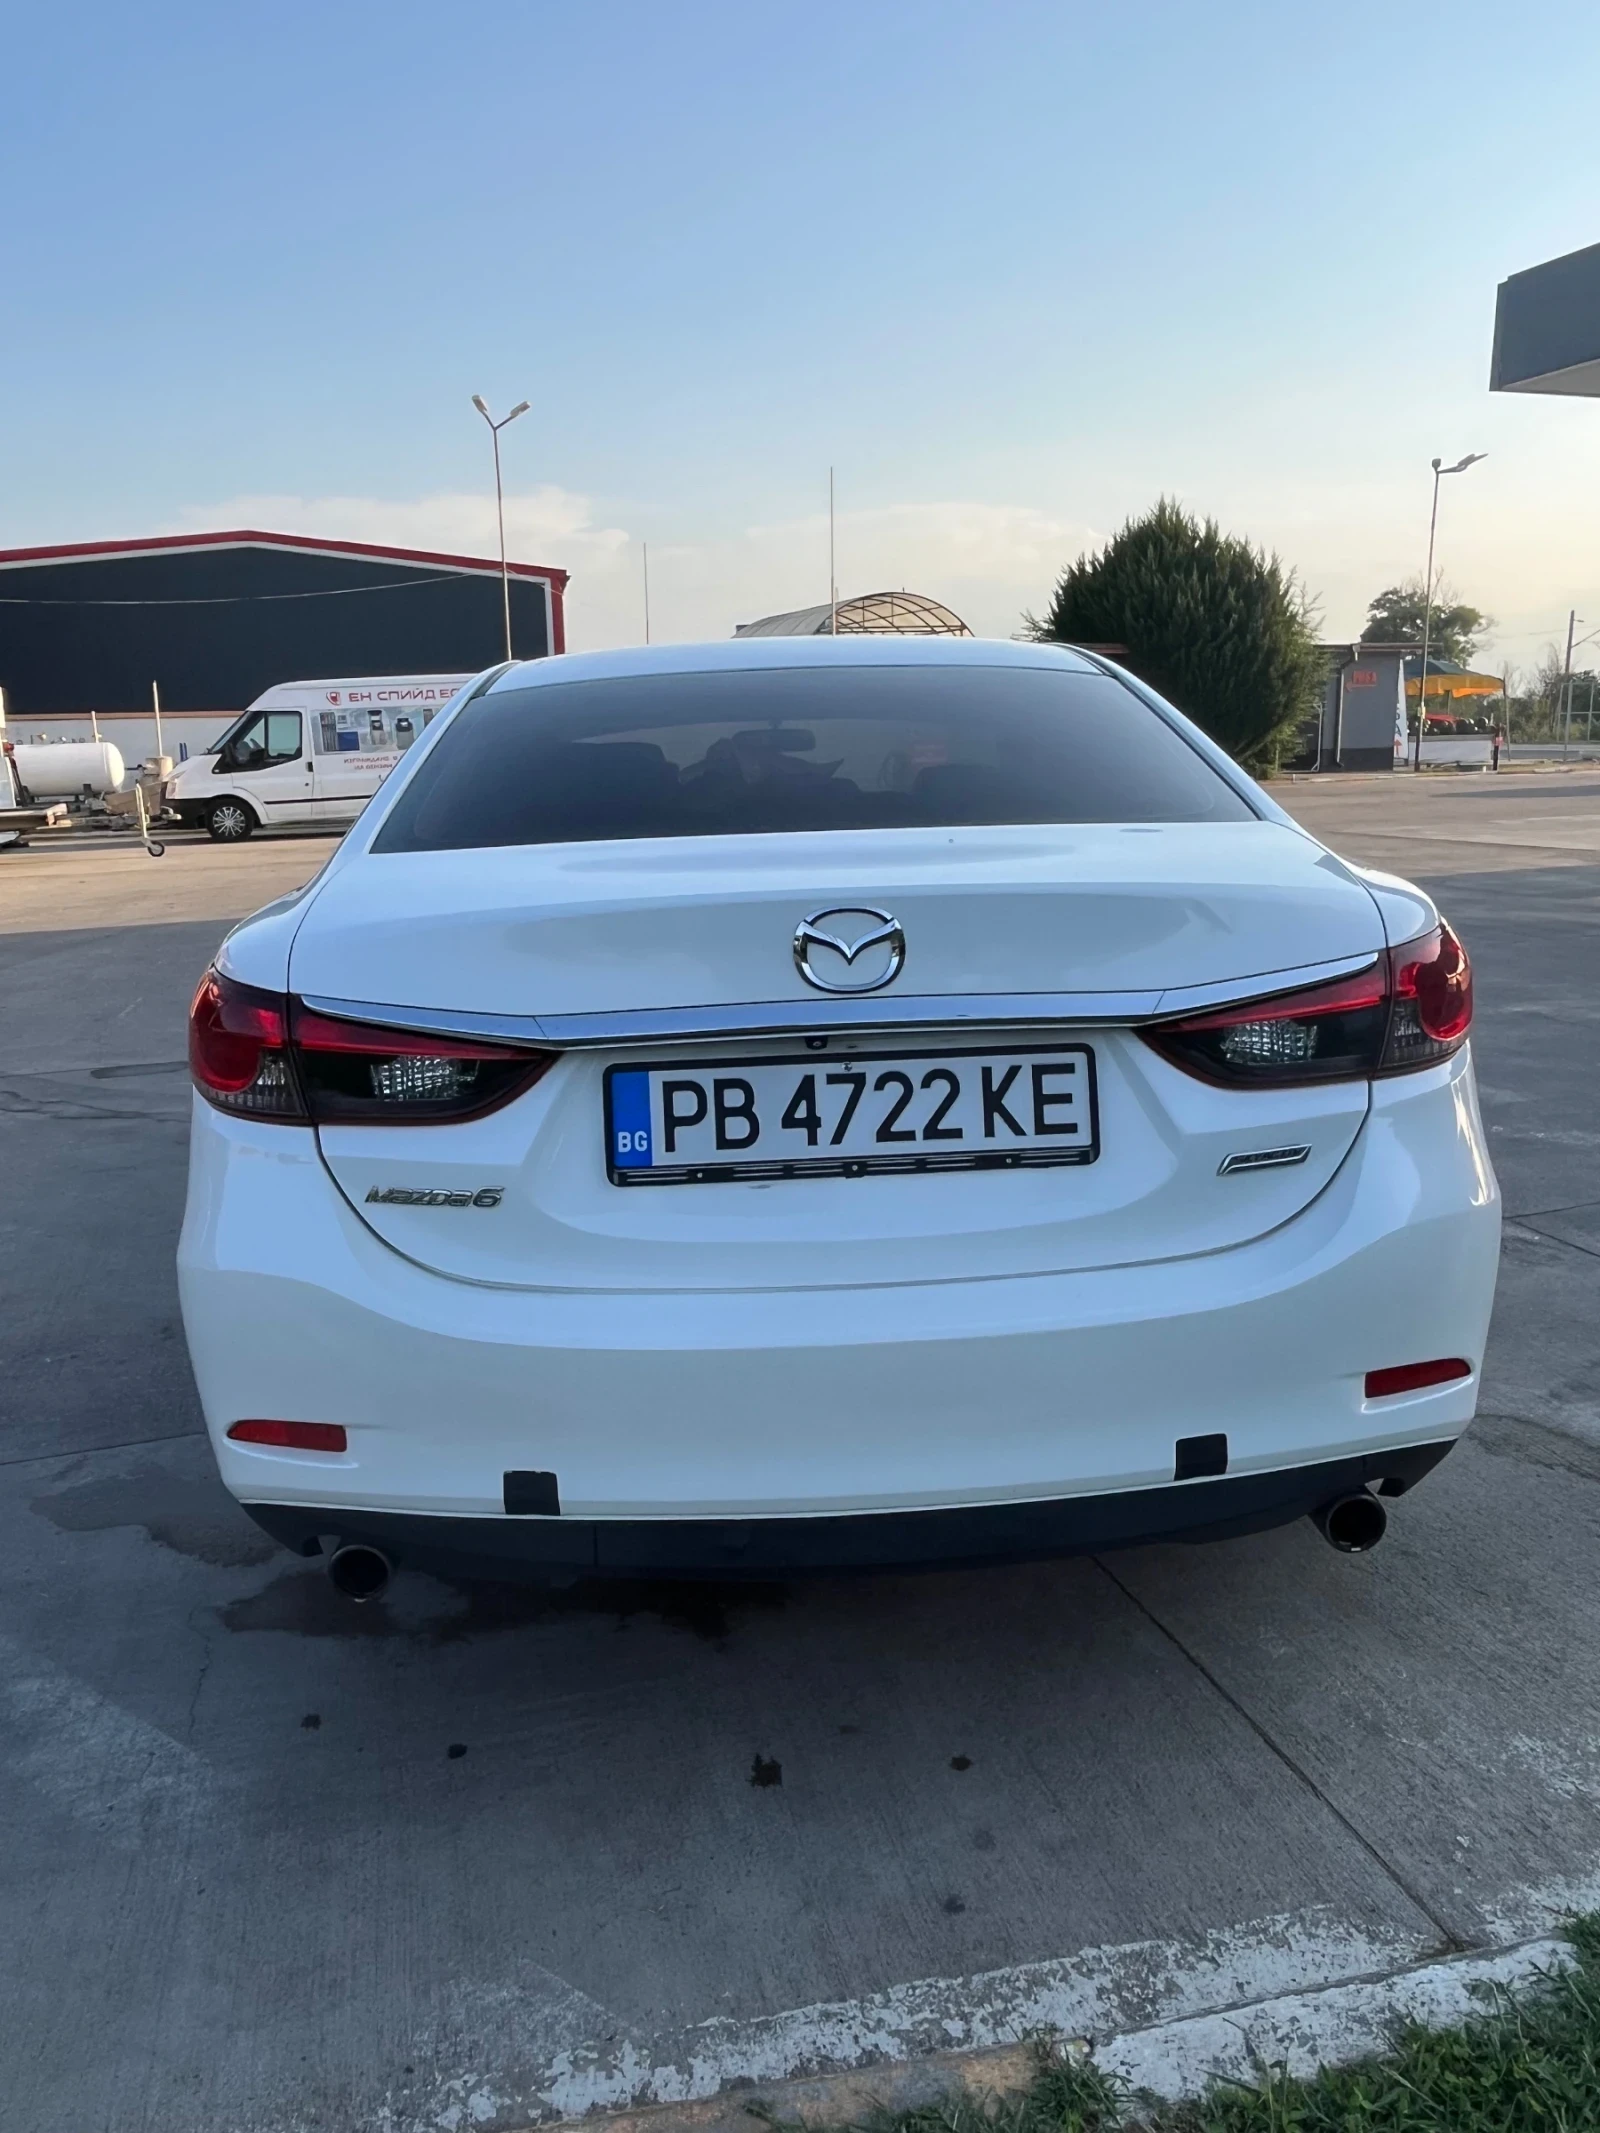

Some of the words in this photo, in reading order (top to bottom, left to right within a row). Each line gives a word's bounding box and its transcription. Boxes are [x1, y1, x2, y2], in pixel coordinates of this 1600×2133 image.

[348, 691, 372, 702] ЕН
[377, 687, 436, 701] СПИЙД
[662, 1078, 760, 1153] PB
[781, 1068, 963, 1146] 4722
[981, 1063, 1078, 1138] KE
[617, 1131, 648, 1153] BG
